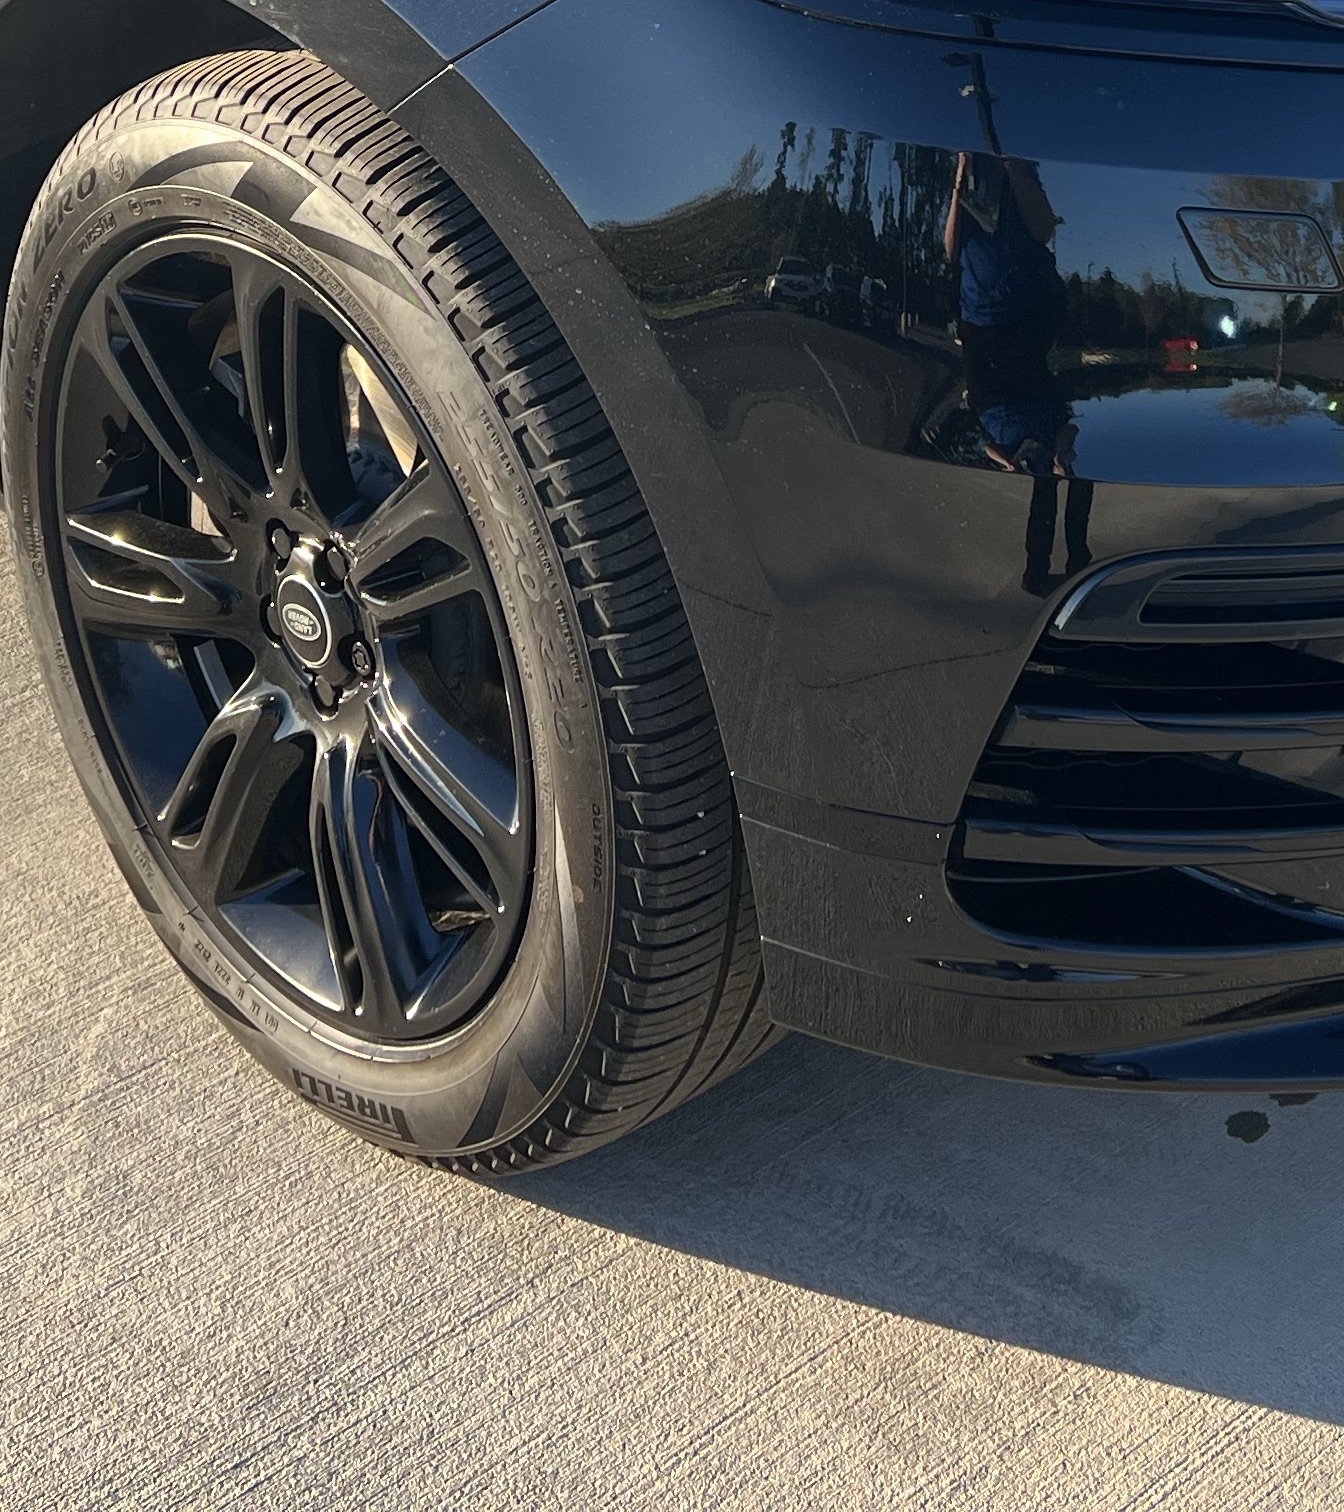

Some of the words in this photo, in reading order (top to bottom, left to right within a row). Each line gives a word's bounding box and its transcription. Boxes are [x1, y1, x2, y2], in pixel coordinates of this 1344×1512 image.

[33, 166, 97, 275] ZERO
[527, 519, 553, 578] TRACTION
[553, 598, 585, 684] TEMPERATURE
[592, 802, 605, 893] OUTSIDE
[292, 1067, 417, 1144] PIRELLI
